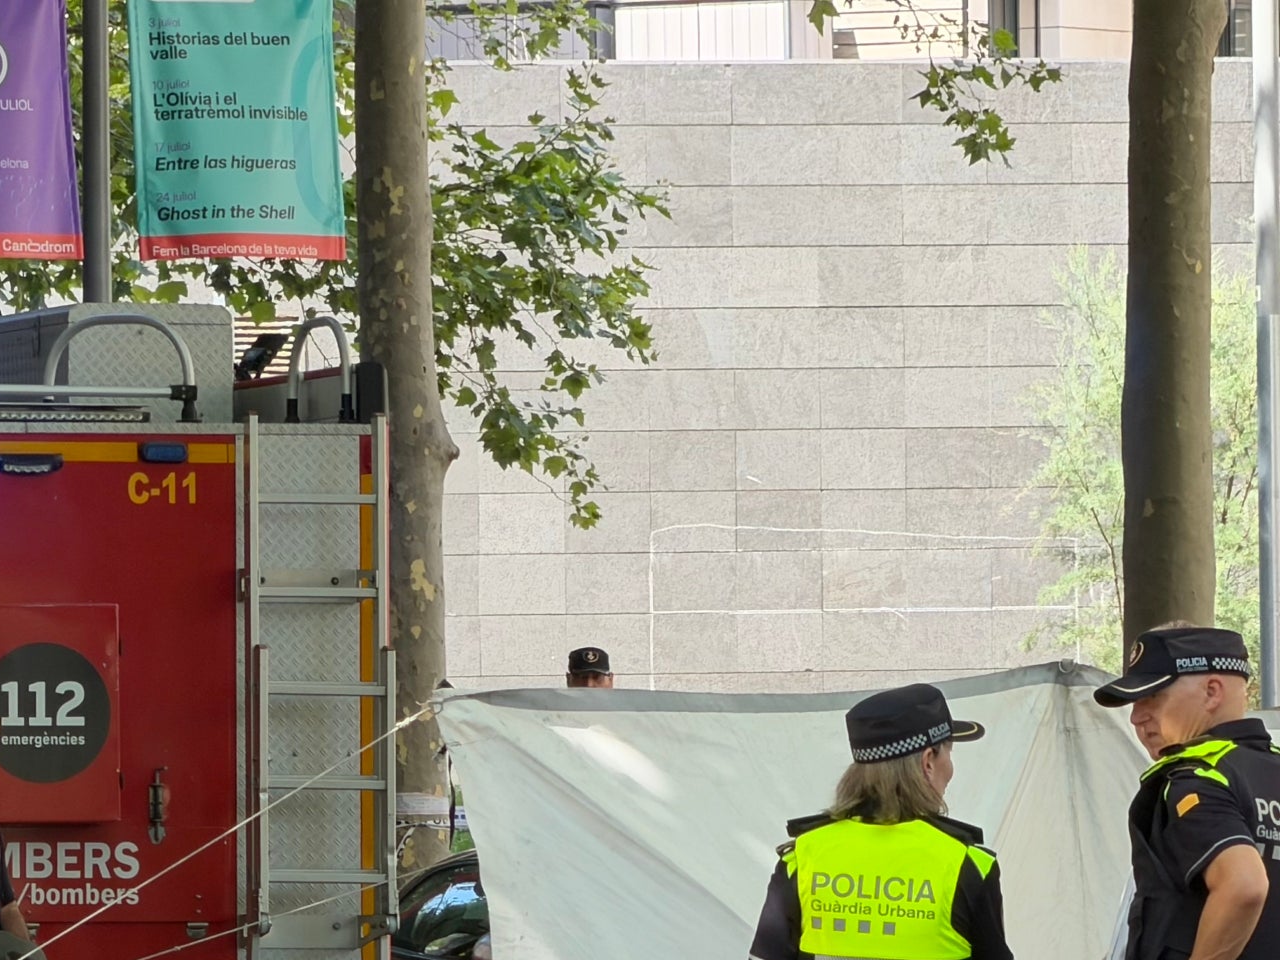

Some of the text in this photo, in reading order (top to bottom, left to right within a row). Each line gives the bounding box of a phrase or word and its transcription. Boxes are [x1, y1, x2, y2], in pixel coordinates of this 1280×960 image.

[148, 31, 290, 46] Historias del buen
[150, 46, 187, 60] valle
[215, 92, 220, 106] i
[223, 92, 237, 106] el
[249, 105, 308, 121] invisible
[155, 154, 296, 173] Entre las higueras
[157, 204, 295, 221] Ghost in the Shell
[180, 245, 190, 256] la
[192, 243, 247, 255] Barcelona
[248, 244, 262, 254] de
[263, 244, 273, 254] la
[274, 244, 297, 255] teva
[297, 244, 318, 256] vida
[128, 471, 197, 504] C-11
[1176, 656, 1208, 668] POLICIA
[1, 681, 85, 726] 112
[1, 731, 85, 748] emergències
[1256, 824, 1280, 840] Guà
[811, 871, 936, 904] POLICIA
[811, 899, 936, 920] Guàrdia Urbana
